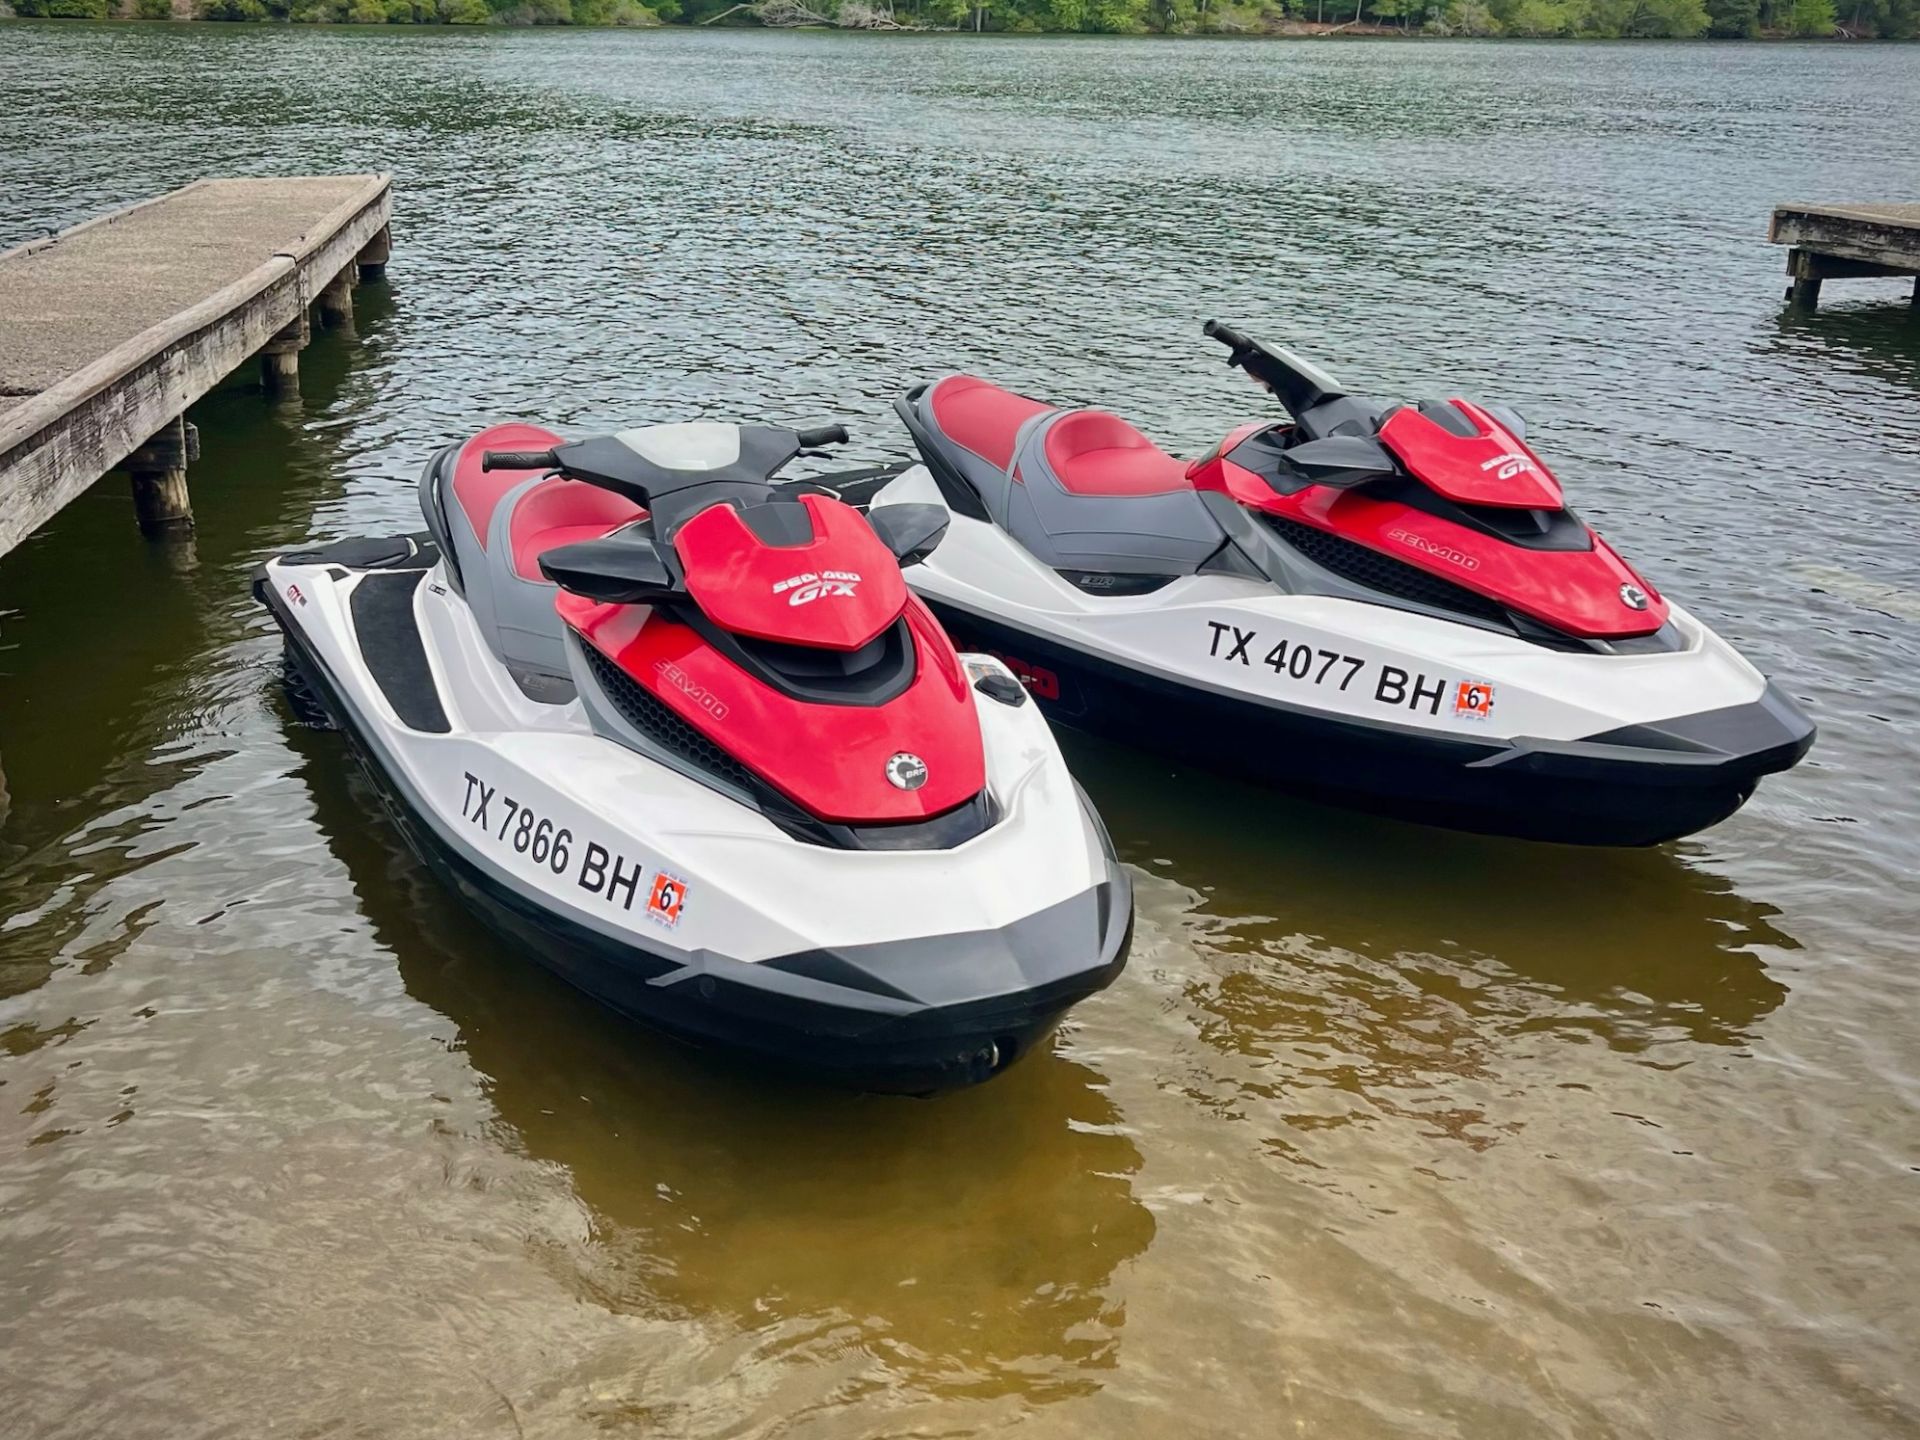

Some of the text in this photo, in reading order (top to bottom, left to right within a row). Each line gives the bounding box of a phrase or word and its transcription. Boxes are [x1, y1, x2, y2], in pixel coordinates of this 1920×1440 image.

[788, 579, 858, 606] GTX
[1208, 621, 1446, 716] TX 4077 BH
[1467, 687, 1480, 709] 6
[463, 771, 642, 911] TX 7866 BH
[660, 882, 675, 911] 6
